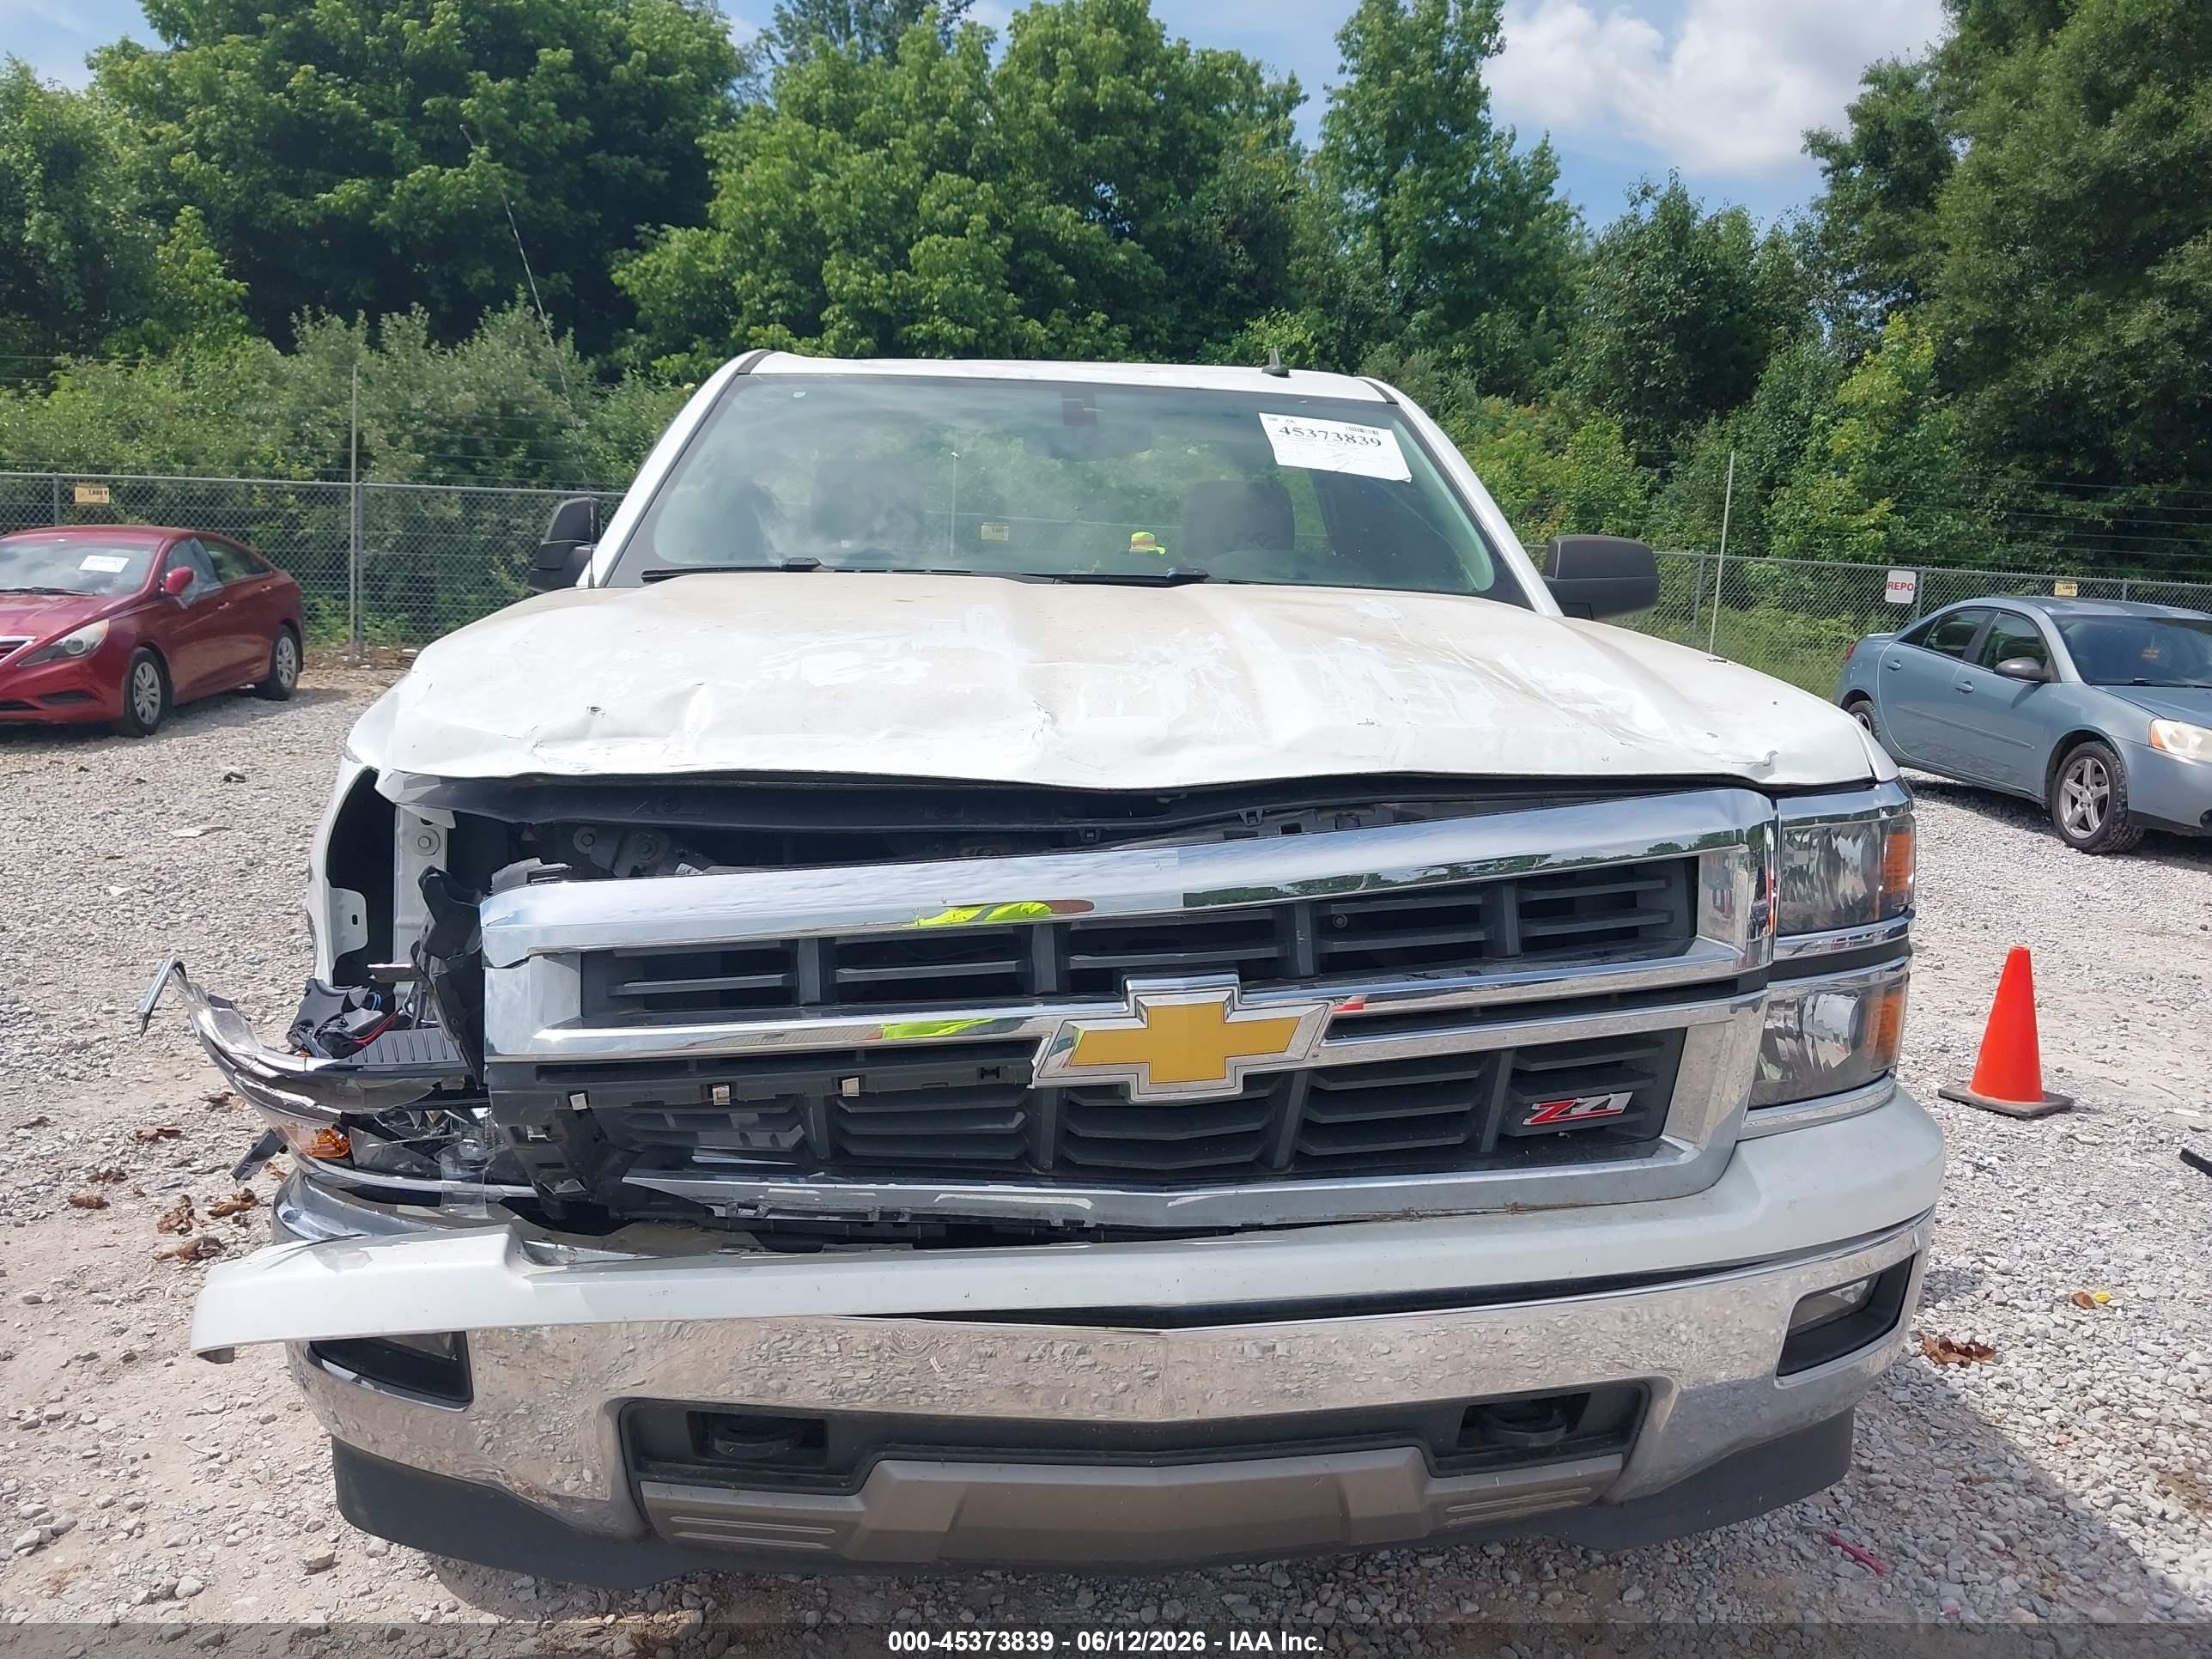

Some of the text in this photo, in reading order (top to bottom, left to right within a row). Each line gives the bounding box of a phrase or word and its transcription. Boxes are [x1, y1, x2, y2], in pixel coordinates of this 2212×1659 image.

[1279, 426, 1382, 447] 45373839
[1887, 581, 1914, 592] REPO
[1522, 1091, 1633, 1125] Z71
